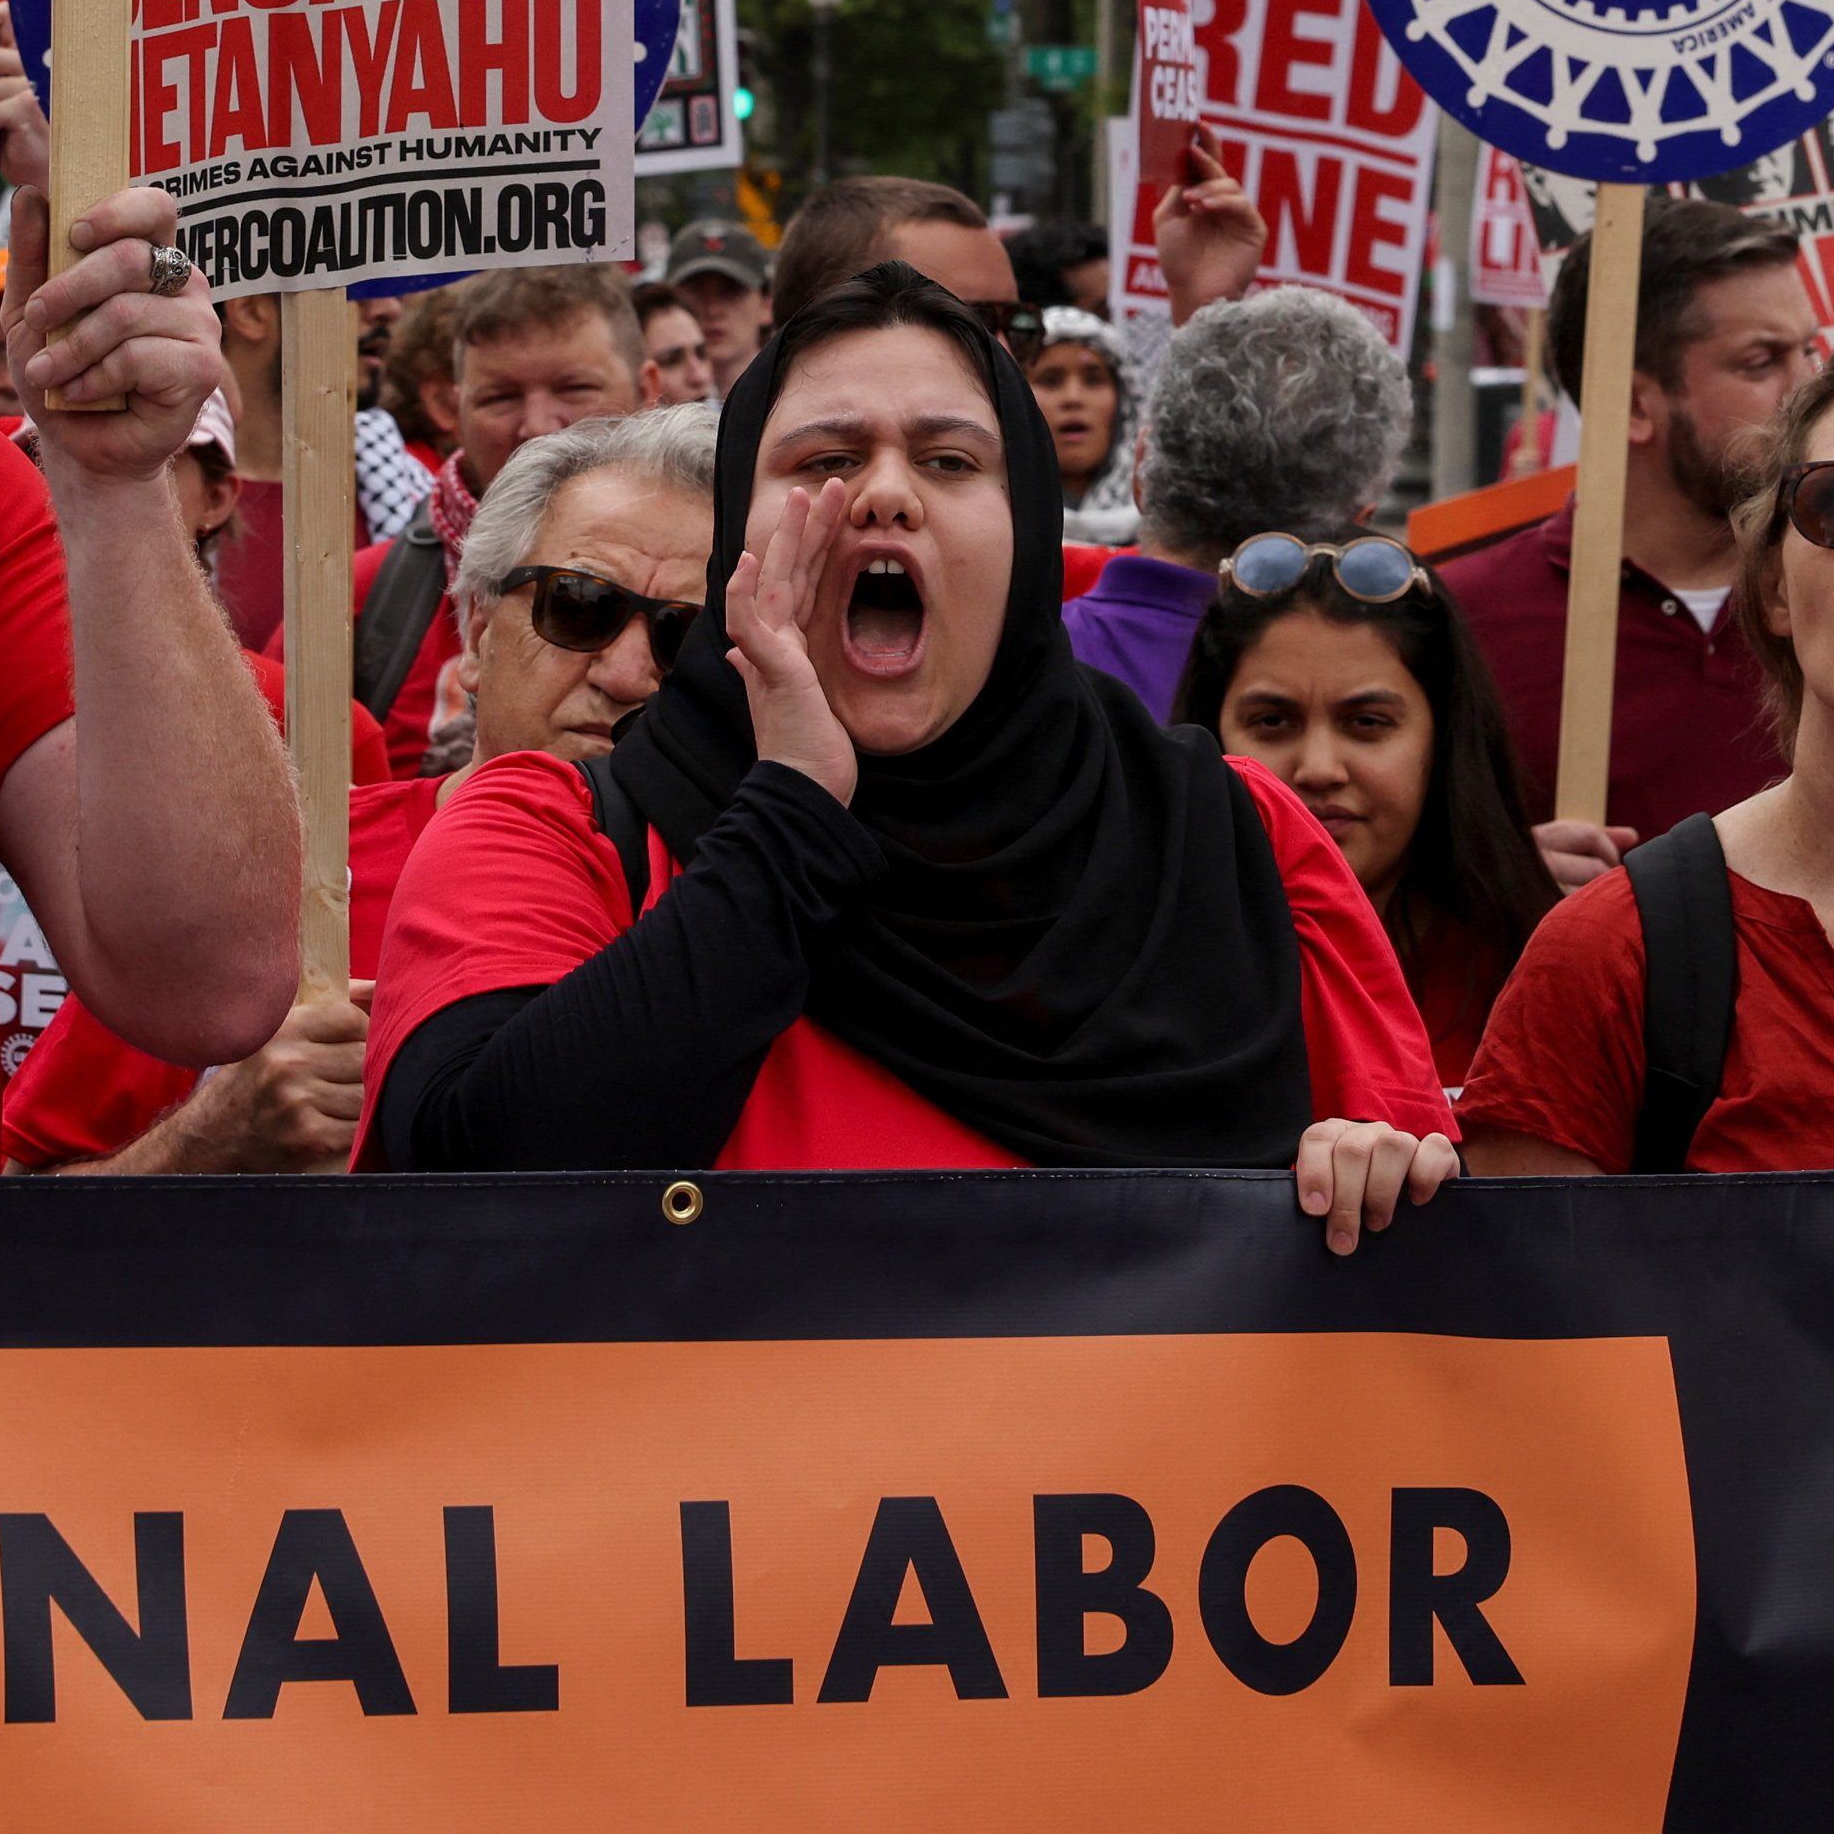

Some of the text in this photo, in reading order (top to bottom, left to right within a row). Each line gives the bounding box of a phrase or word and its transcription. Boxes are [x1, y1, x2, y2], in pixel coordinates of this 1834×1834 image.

[1672, 1, 1756, 53] AMERICA
[247, 142, 391, 181] AGAINST
[399, 127, 602, 162] HUMANITY
[680, 1483, 1528, 1708] LABOR
